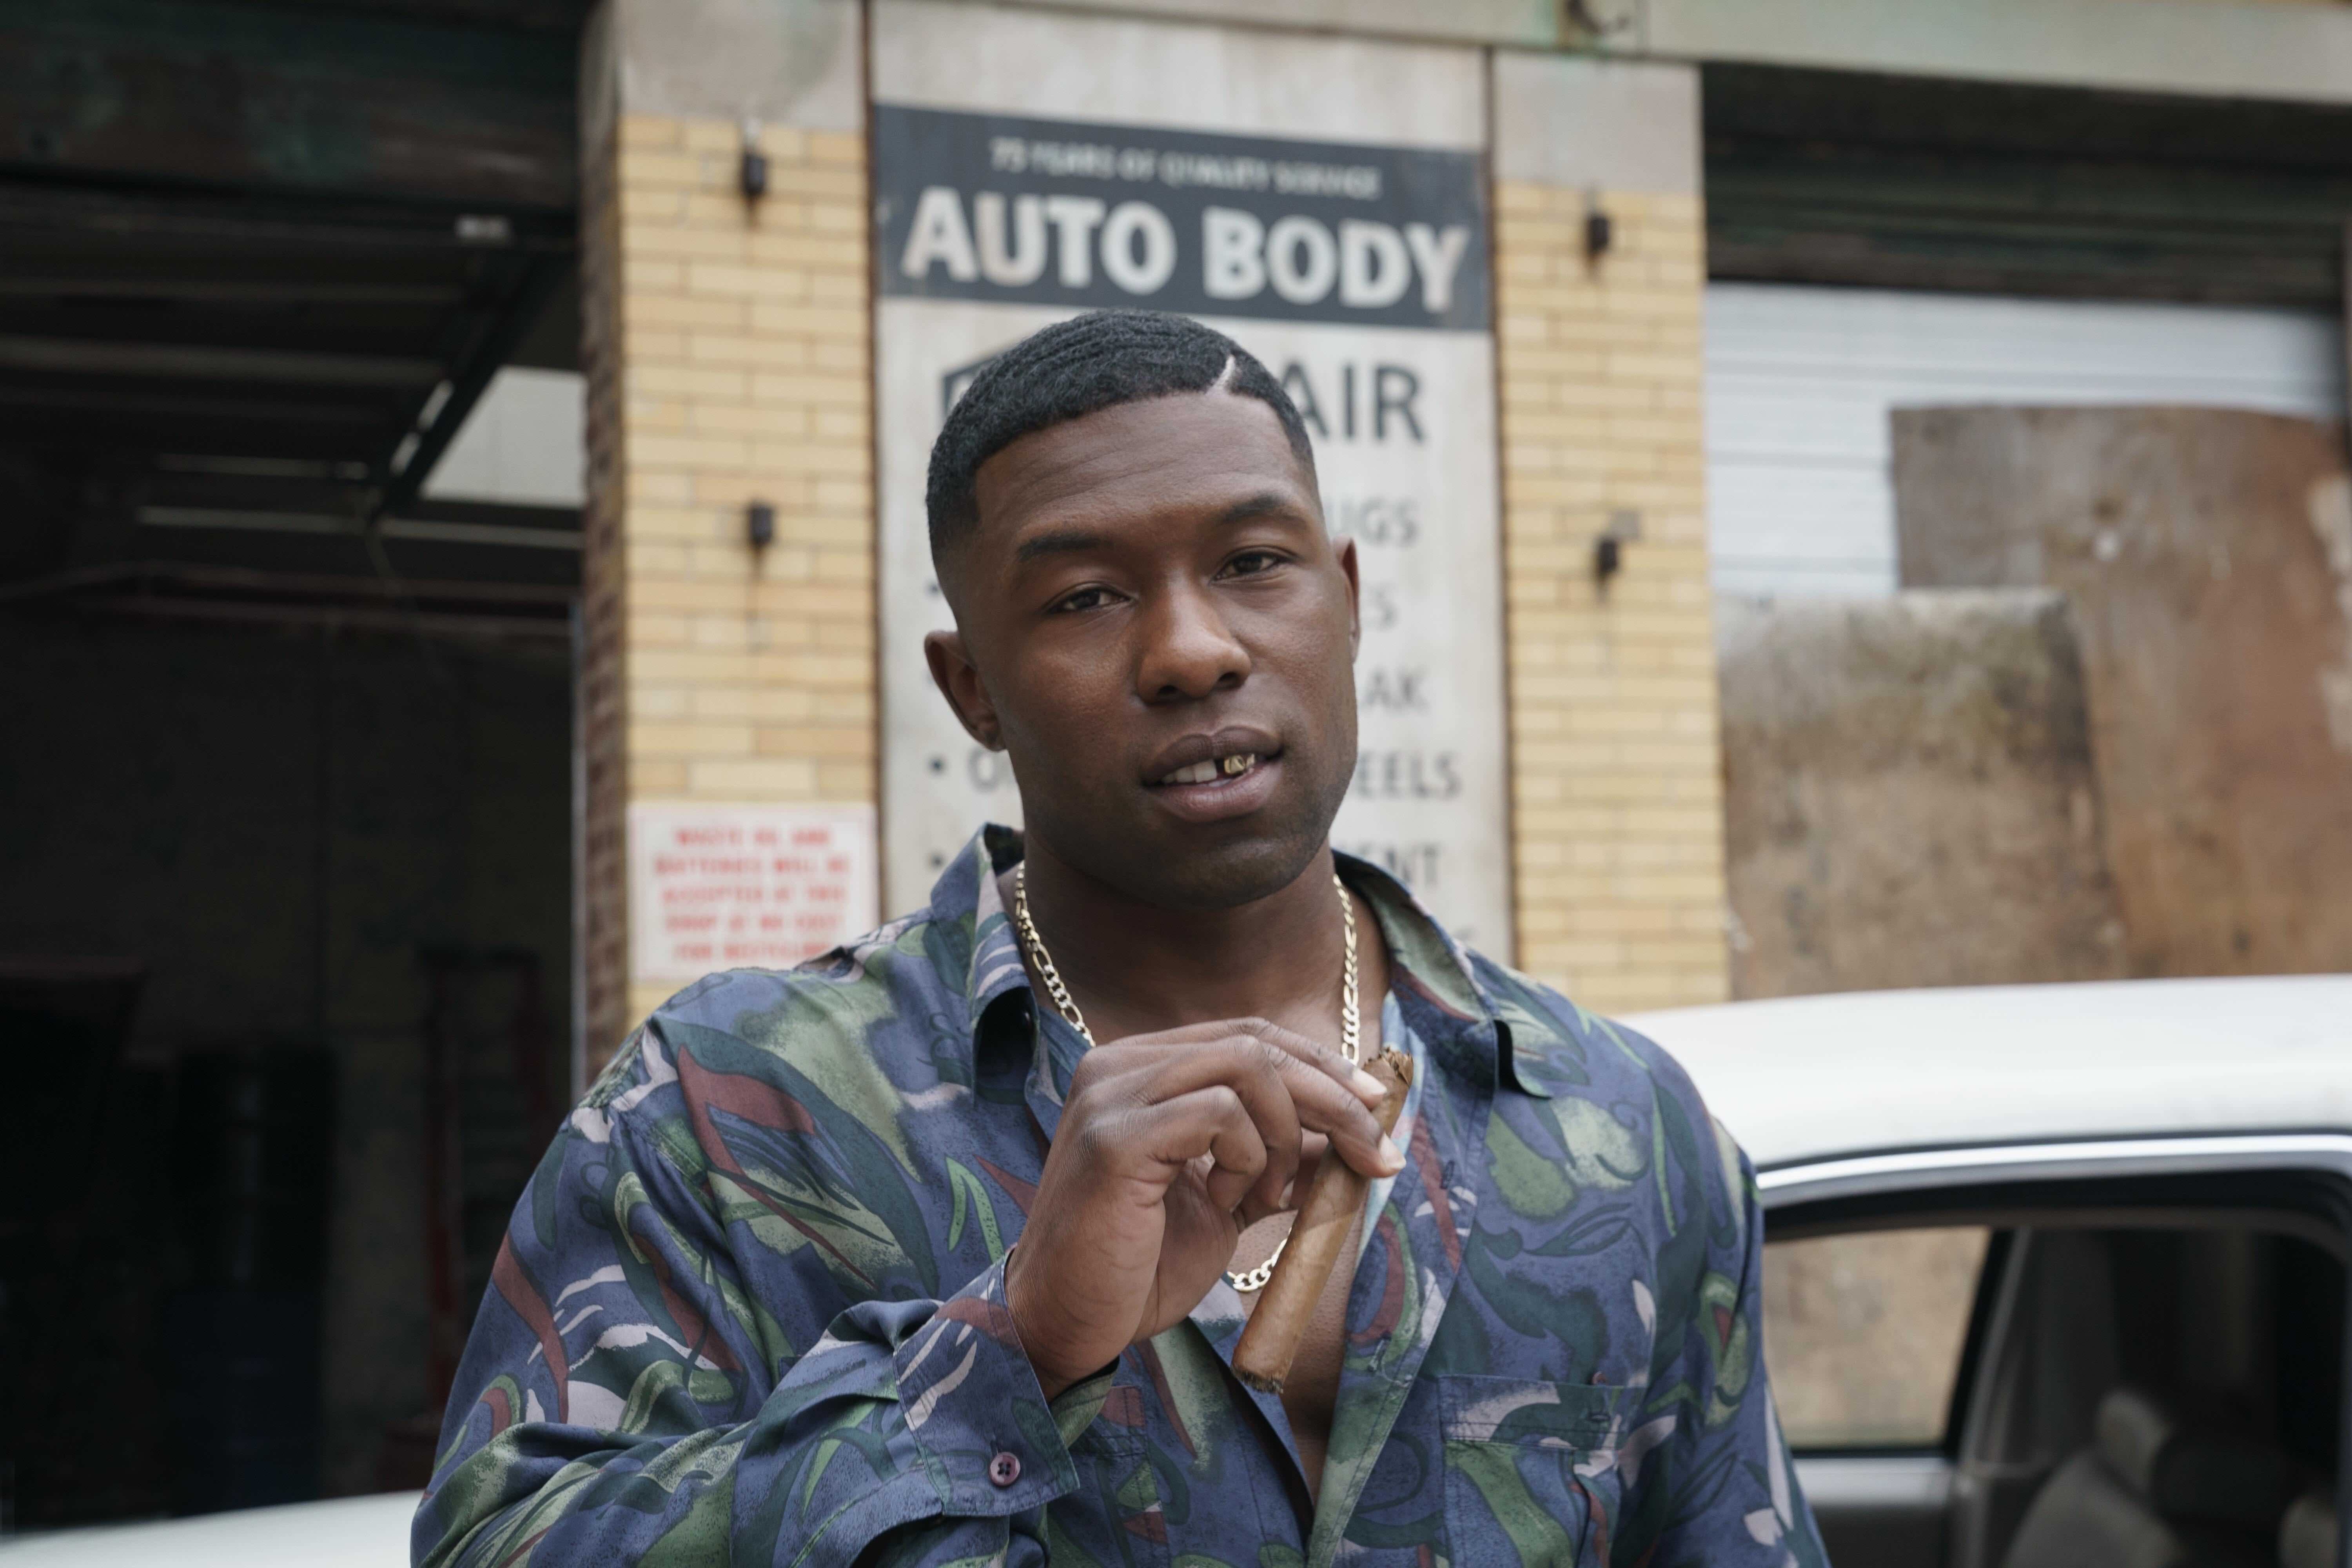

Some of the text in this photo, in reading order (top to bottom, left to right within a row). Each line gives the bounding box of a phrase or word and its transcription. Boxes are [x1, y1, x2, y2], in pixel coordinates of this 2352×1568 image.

[1118, 148, 1156, 182] OF
[900, 186, 1471, 312] AUTO BODY
[1280, 361, 1426, 444] AIR
[1326, 497, 1419, 546] UGS
[1359, 666, 1432, 717] AK
[1353, 750, 1465, 800] EELS
